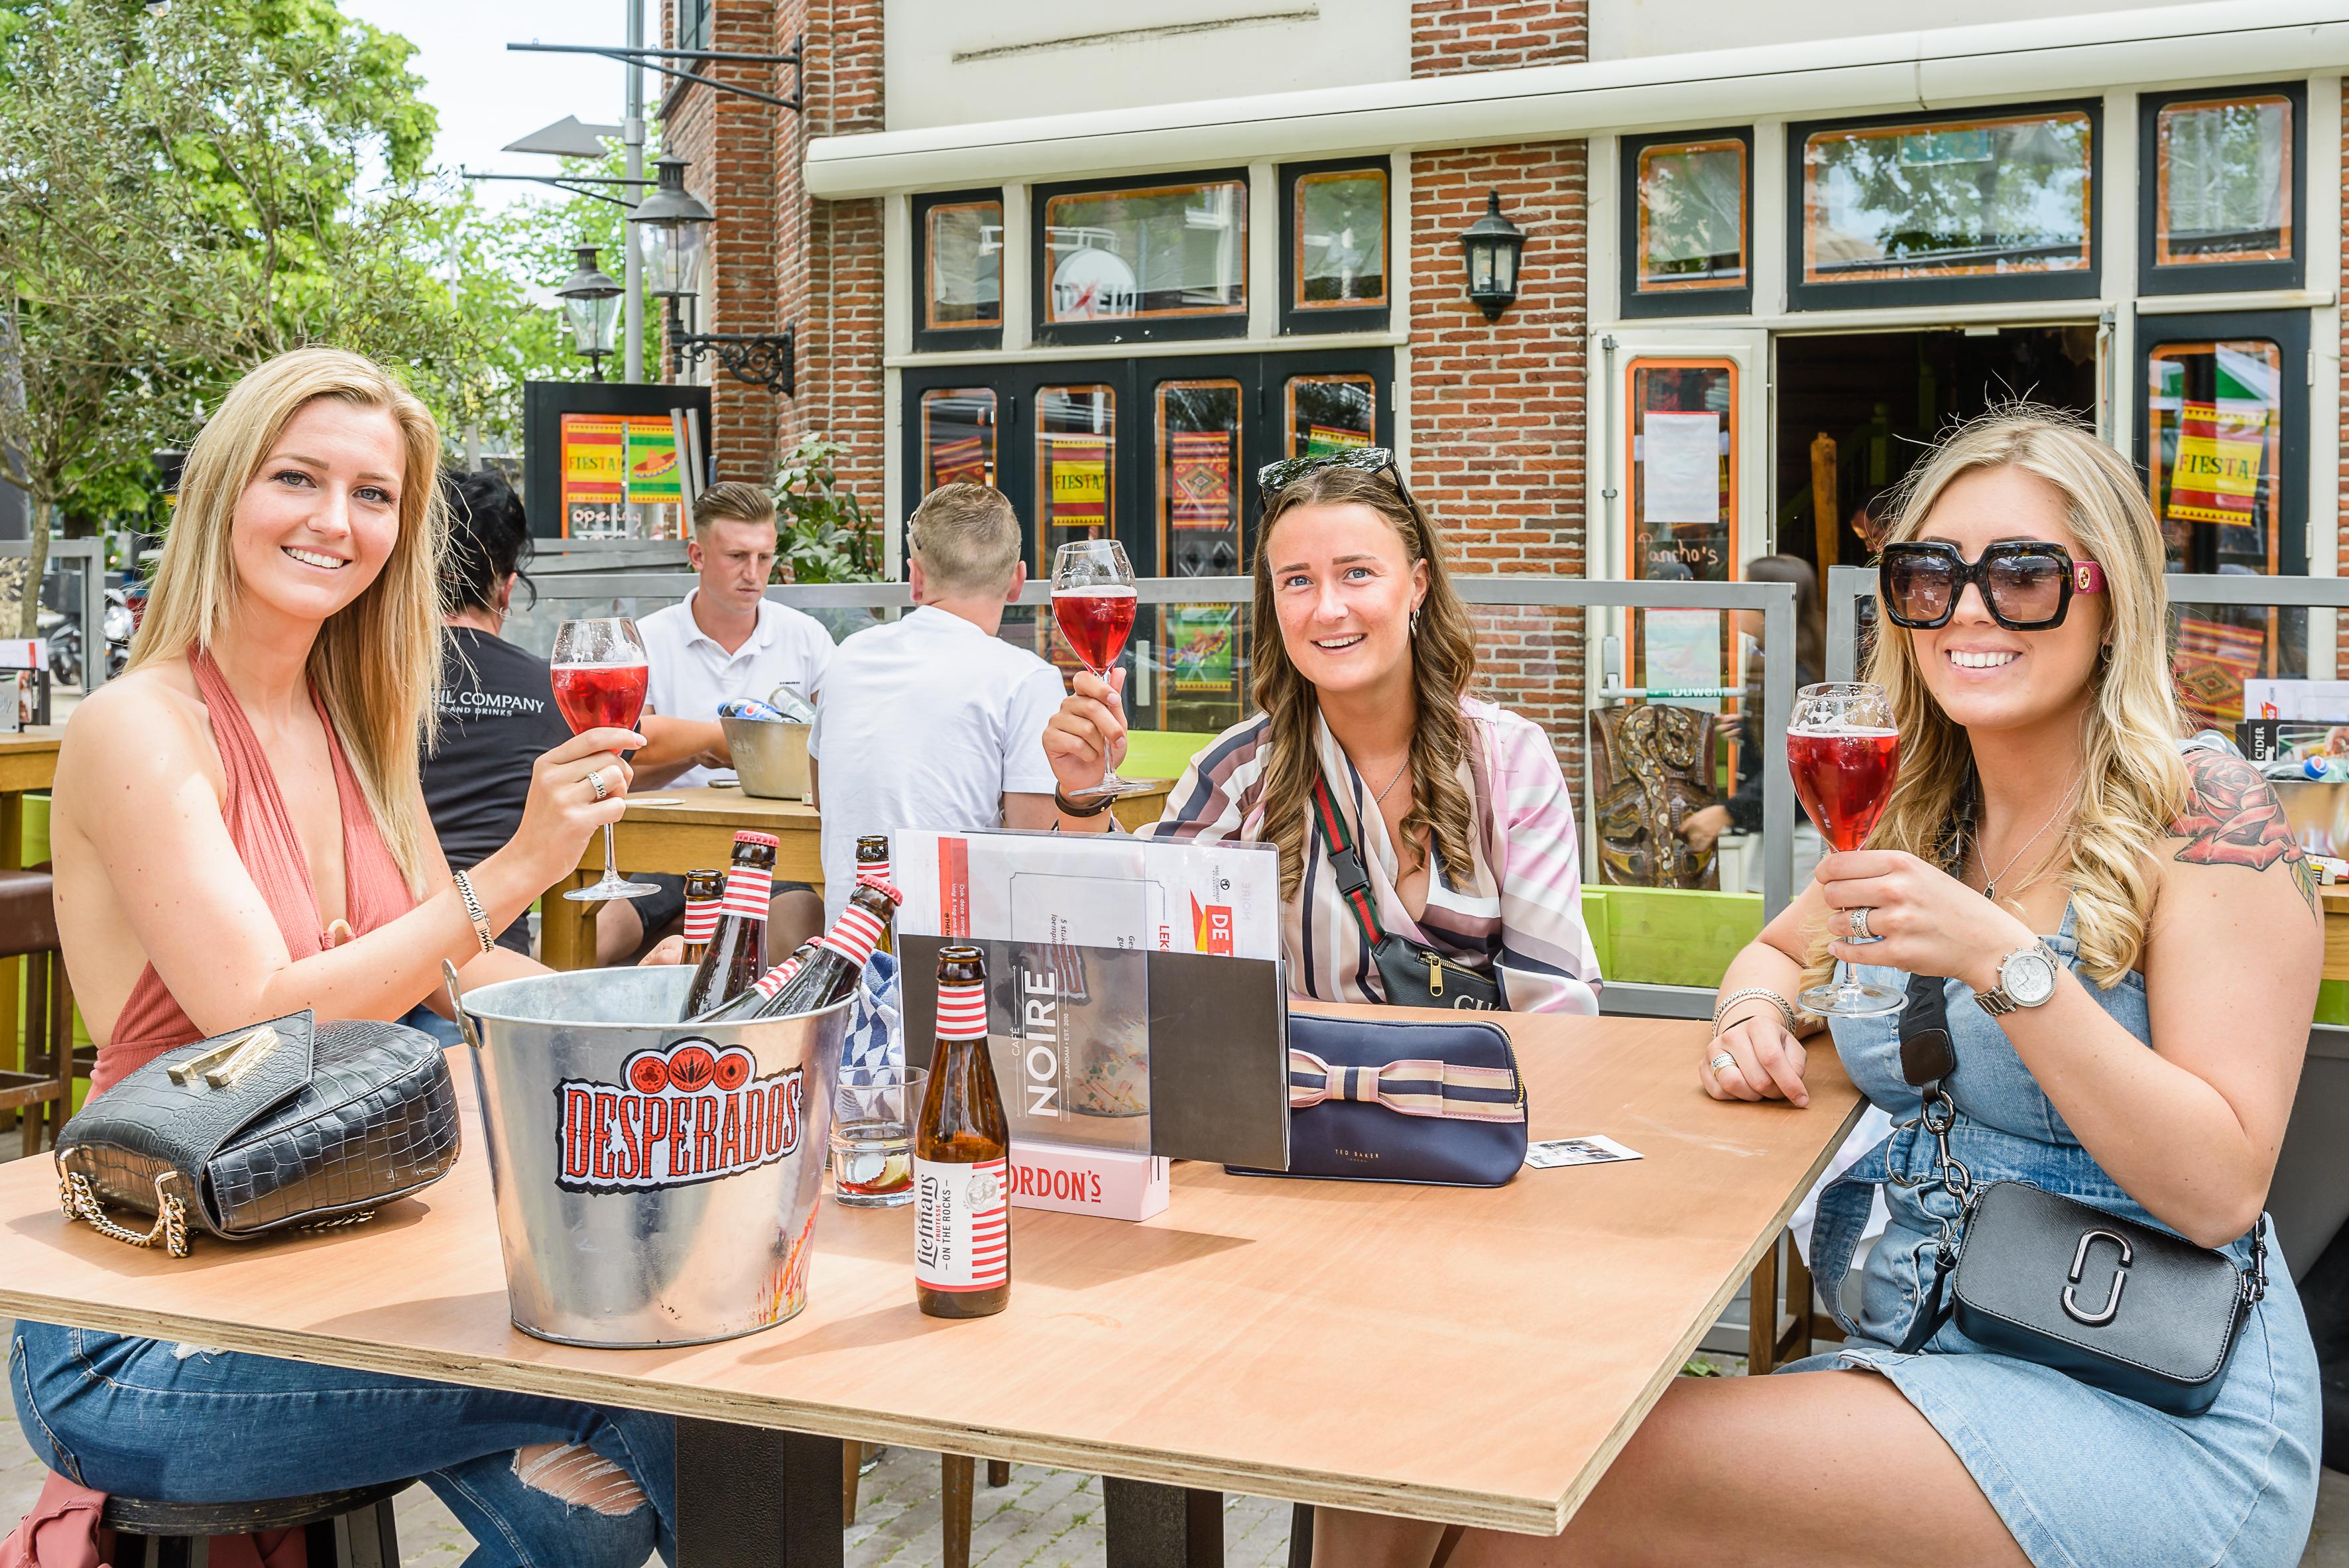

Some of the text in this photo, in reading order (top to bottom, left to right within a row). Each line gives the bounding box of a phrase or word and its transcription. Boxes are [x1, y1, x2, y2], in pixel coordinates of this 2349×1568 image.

[568, 455, 621, 470] FIESTA!
[2178, 453, 2258, 479] FIESTA!
[1055, 473, 1105, 490] FIESTA!
[1638, 532, 1718, 565] Pancho's
[459, 691, 545, 714] COMPANY
[475, 707, 512, 717] DRINKS
[2255, 726, 2265, 760] CIDER
[1211, 914, 1230, 941] DE
[1010, 1026, 1020, 1056] CAFÉ
[1024, 971, 1059, 1117] NOIRE
[566, 1078, 799, 1179] DESPERADOS
[918, 1174, 938, 1270] Liefmans
[942, 1189, 951, 1260] ON THE ROCKS
